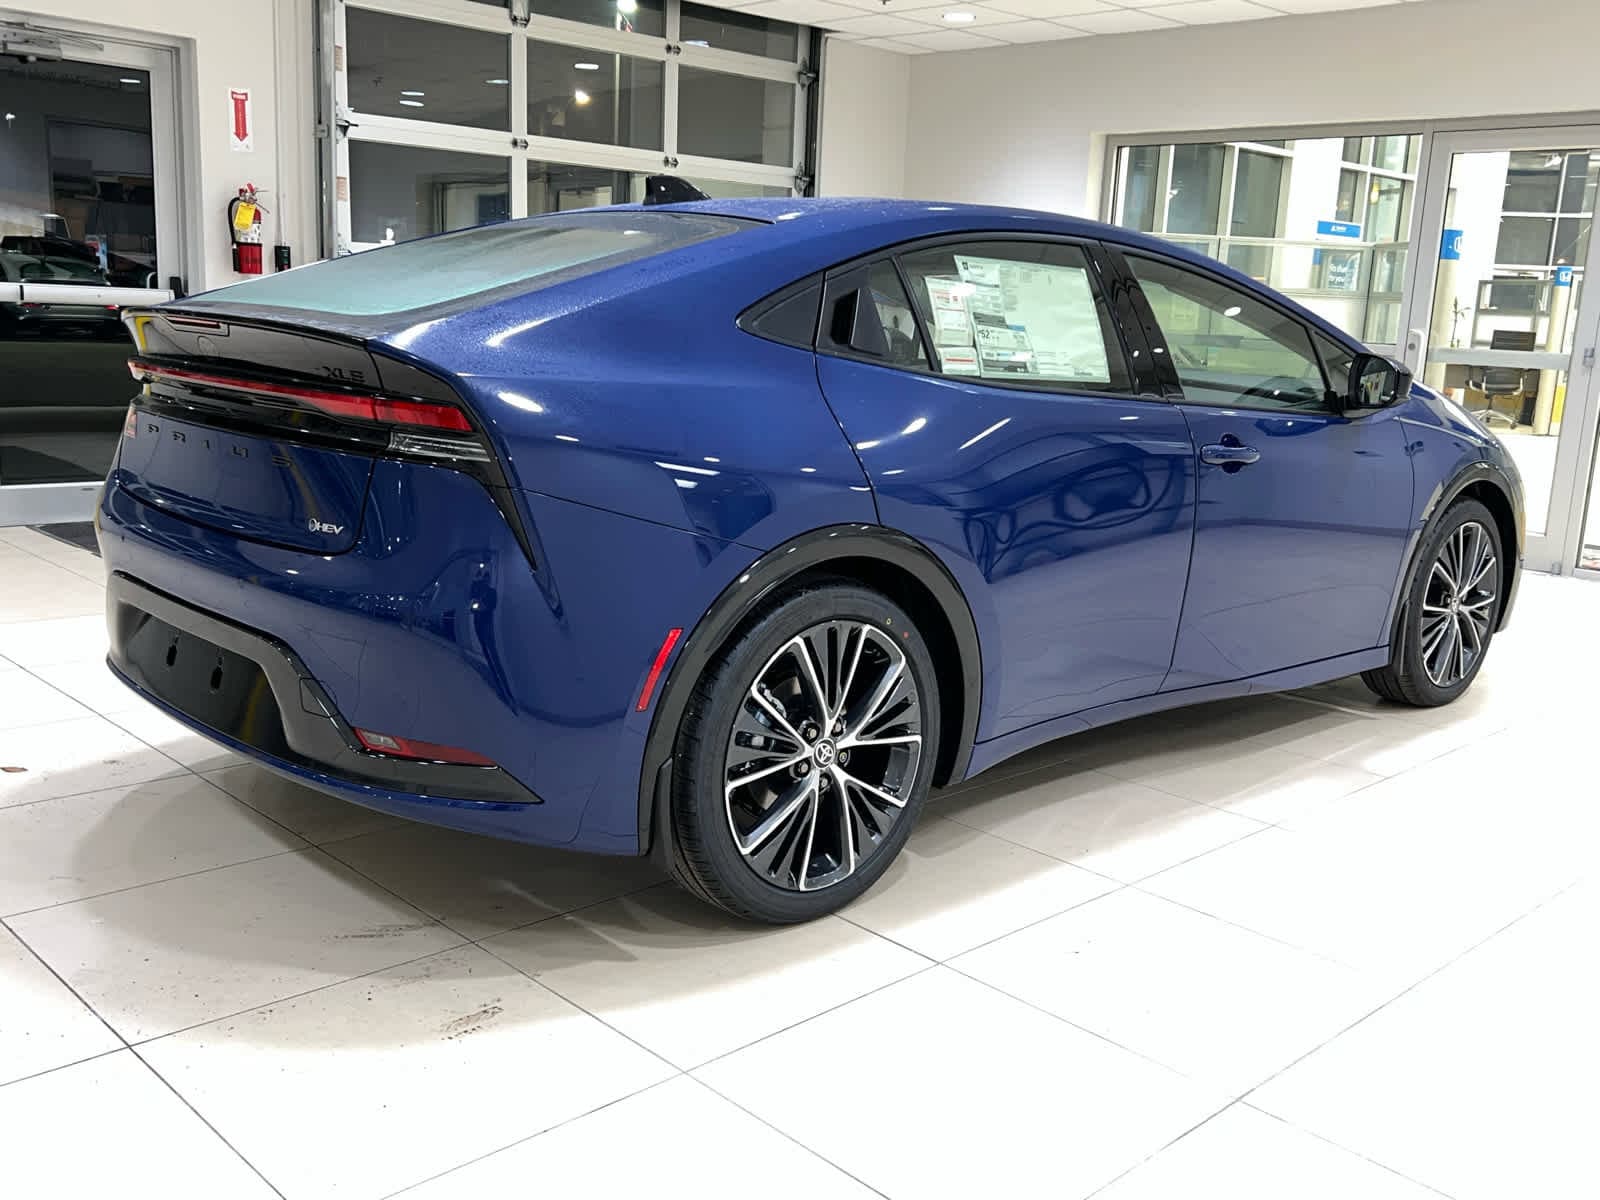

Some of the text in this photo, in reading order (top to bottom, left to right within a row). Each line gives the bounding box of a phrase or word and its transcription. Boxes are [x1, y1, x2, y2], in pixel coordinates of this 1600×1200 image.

[322, 366, 364, 382] XLE
[146, 423, 293, 467] PRIUS
[317, 521, 343, 534] HEV
